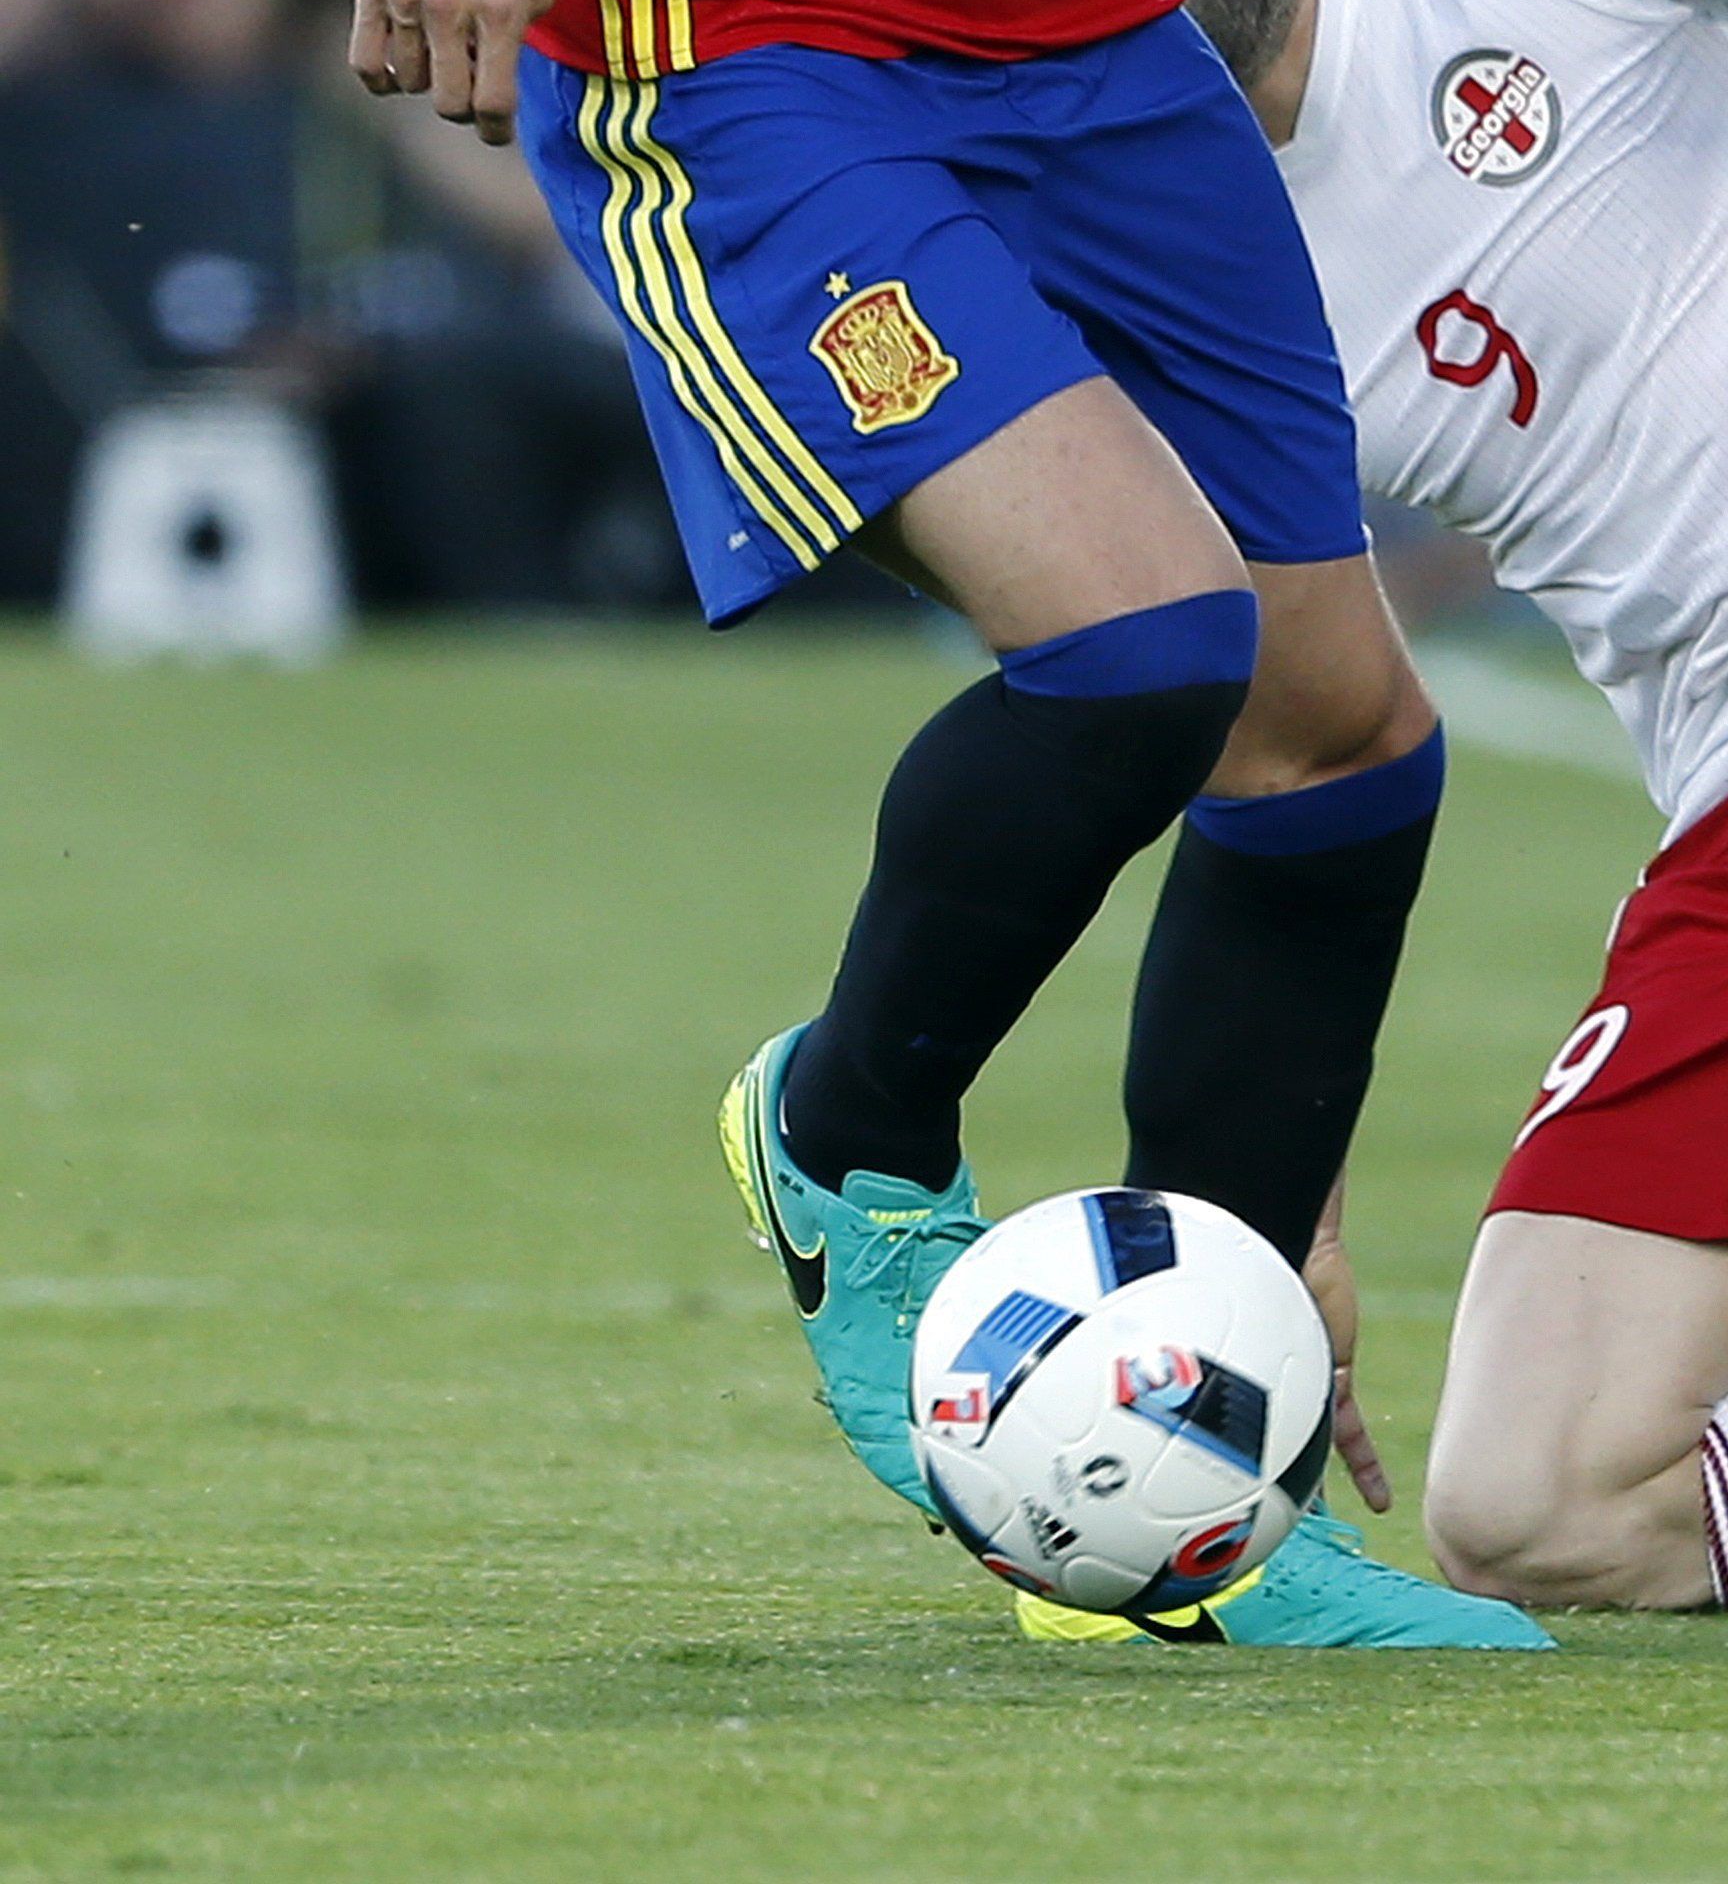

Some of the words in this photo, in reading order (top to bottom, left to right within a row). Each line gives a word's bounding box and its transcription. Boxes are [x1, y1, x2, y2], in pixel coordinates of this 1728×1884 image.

[1454, 64, 1542, 169] Georgia
[1416, 288, 1539, 430] 9
[1513, 1003, 1630, 1150] 9
